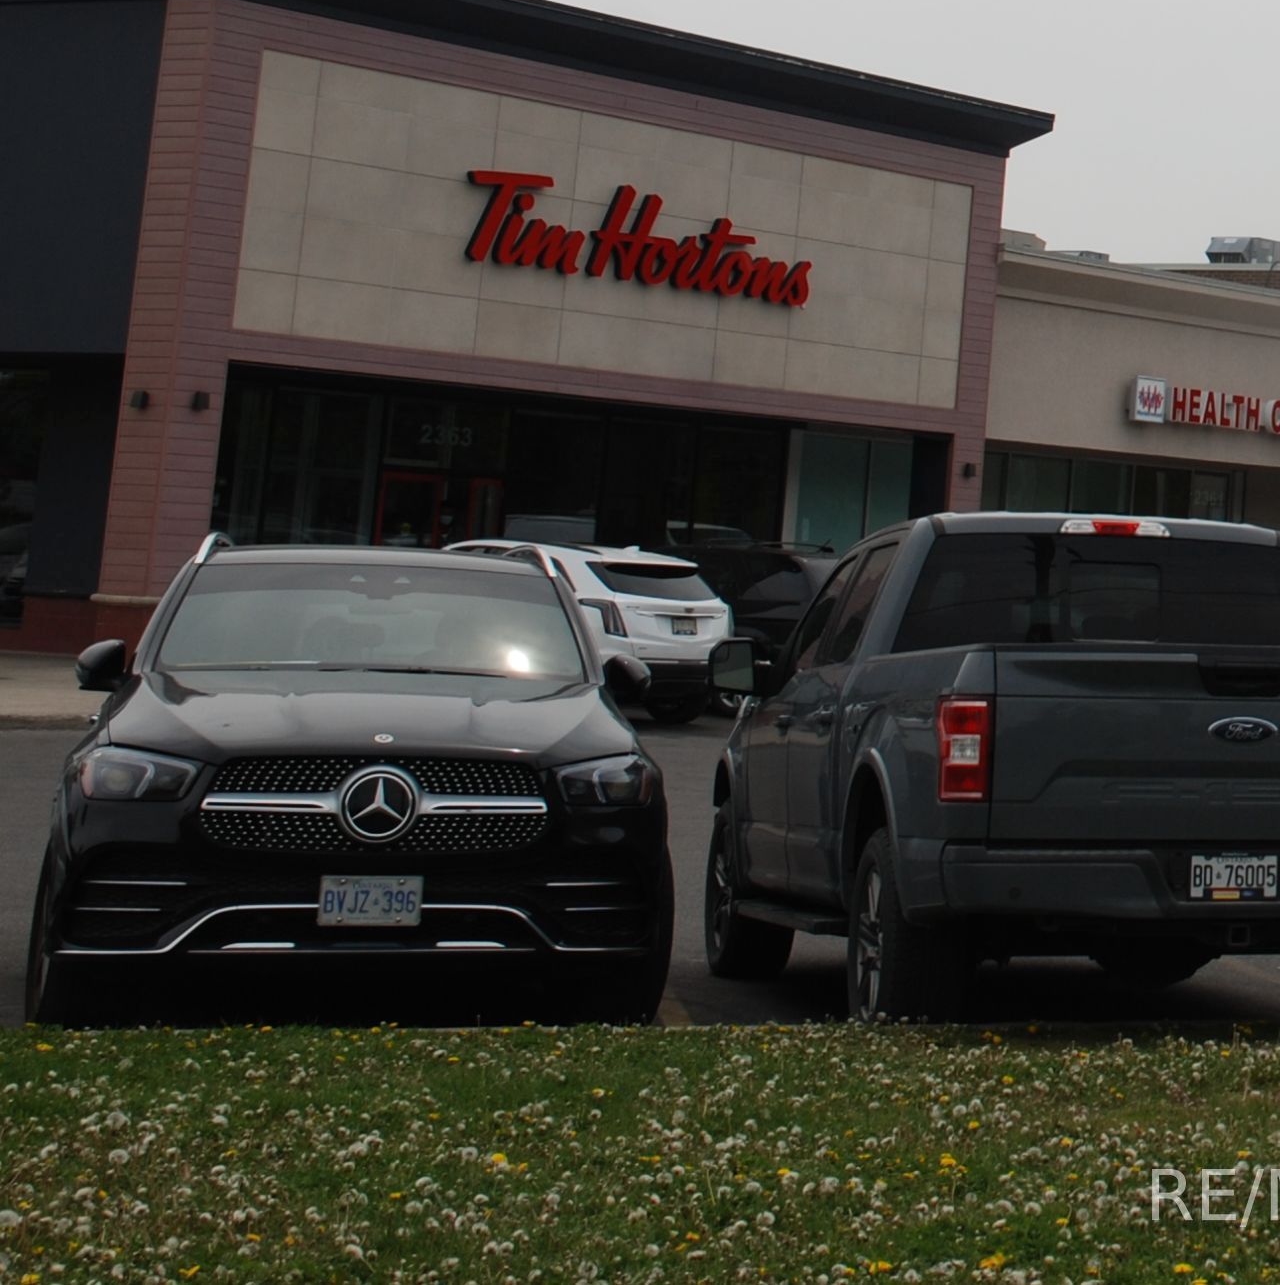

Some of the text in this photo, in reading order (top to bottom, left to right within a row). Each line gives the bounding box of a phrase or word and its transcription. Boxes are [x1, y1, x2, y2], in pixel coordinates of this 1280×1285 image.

[466, 169, 814, 310] Tim Hortons
[1171, 386, 1261, 431] HEALTH
[419, 424, 474, 448] 2363
[1224, 722, 1264, 740] Ford
[1224, 864, 1277, 888] 76005
[323, 889, 417, 914] BVJZ 396
